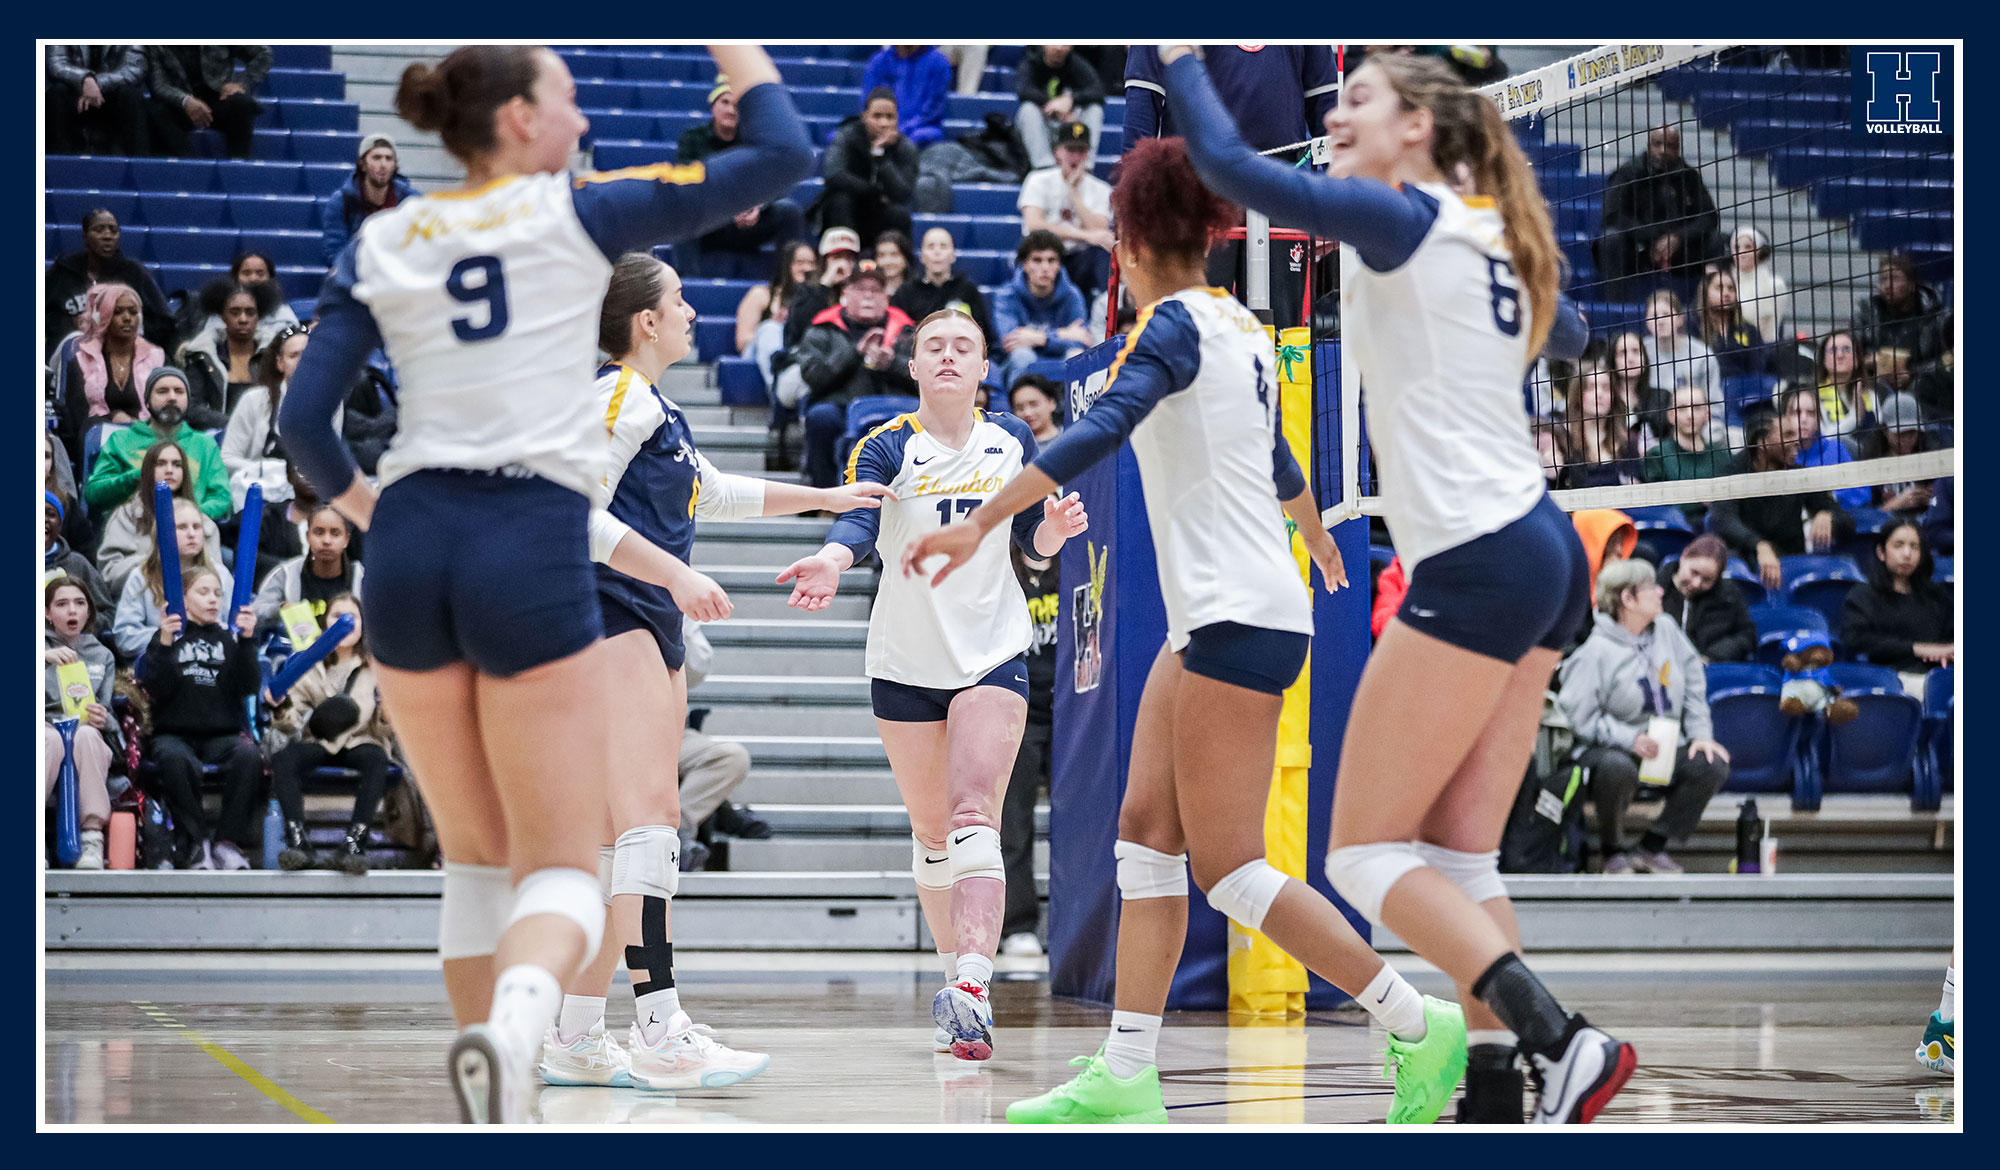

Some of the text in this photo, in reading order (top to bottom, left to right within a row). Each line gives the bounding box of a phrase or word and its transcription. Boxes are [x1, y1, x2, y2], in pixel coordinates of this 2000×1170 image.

[446, 255, 508, 342] 9
[914, 470, 1004, 496] Humber
[936, 498, 983, 528] 17
